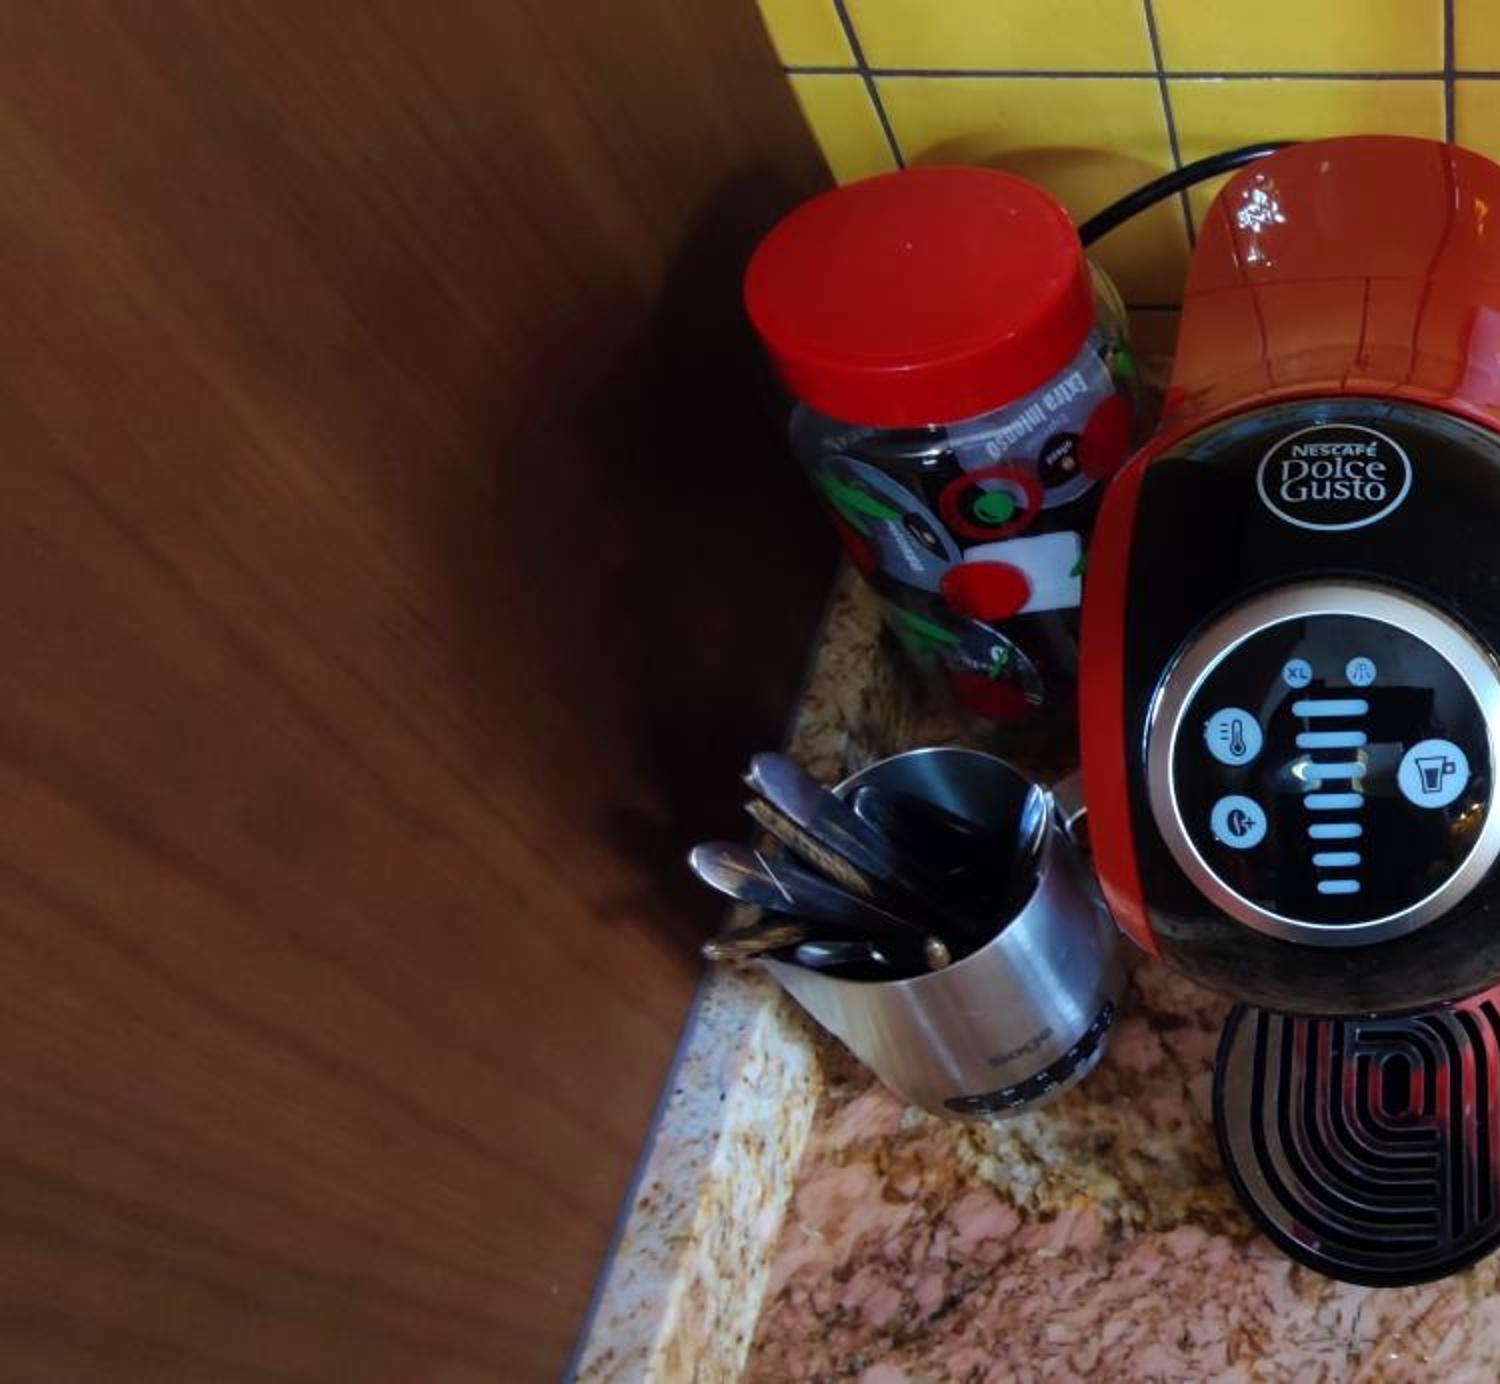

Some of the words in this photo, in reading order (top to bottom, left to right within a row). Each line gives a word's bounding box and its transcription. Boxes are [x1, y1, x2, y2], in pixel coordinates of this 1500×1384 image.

[1292, 441, 1377, 457] NESCAFÉ
[1281, 457, 1387, 481] Dolce
[1280, 478, 1387, 503] Gusto
[1287, 666, 1309, 681] XL
